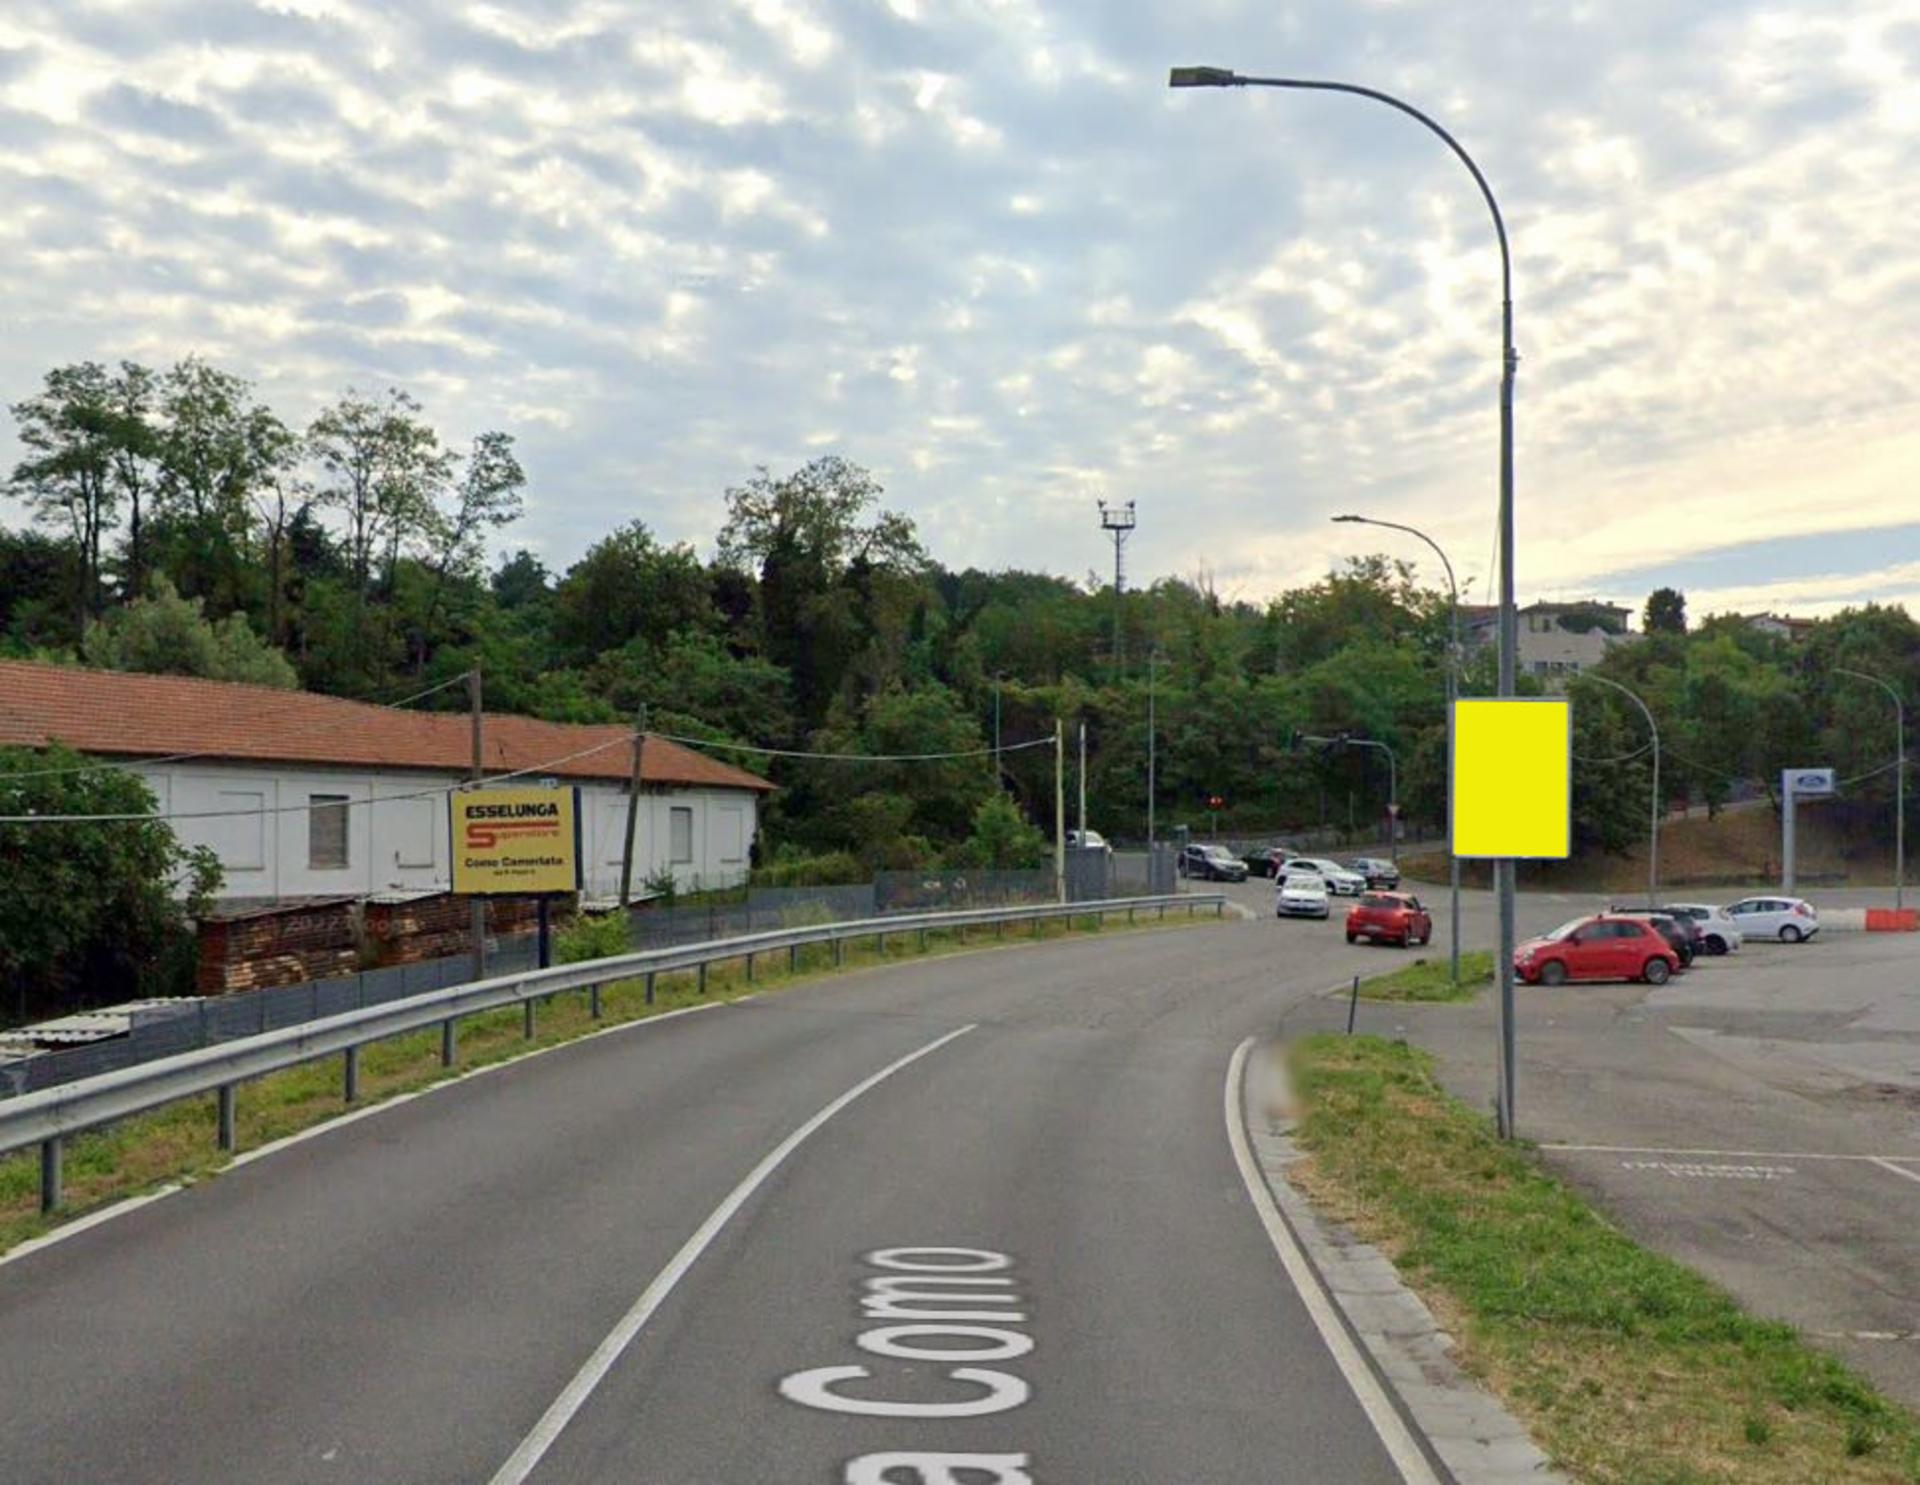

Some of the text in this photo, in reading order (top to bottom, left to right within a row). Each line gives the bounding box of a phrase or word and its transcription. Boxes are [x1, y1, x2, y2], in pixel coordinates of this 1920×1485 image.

[466, 803, 558, 818] ESSELUNGA
[465, 858, 498, 868] Como
[777, 1246, 1036, 1419] Como
